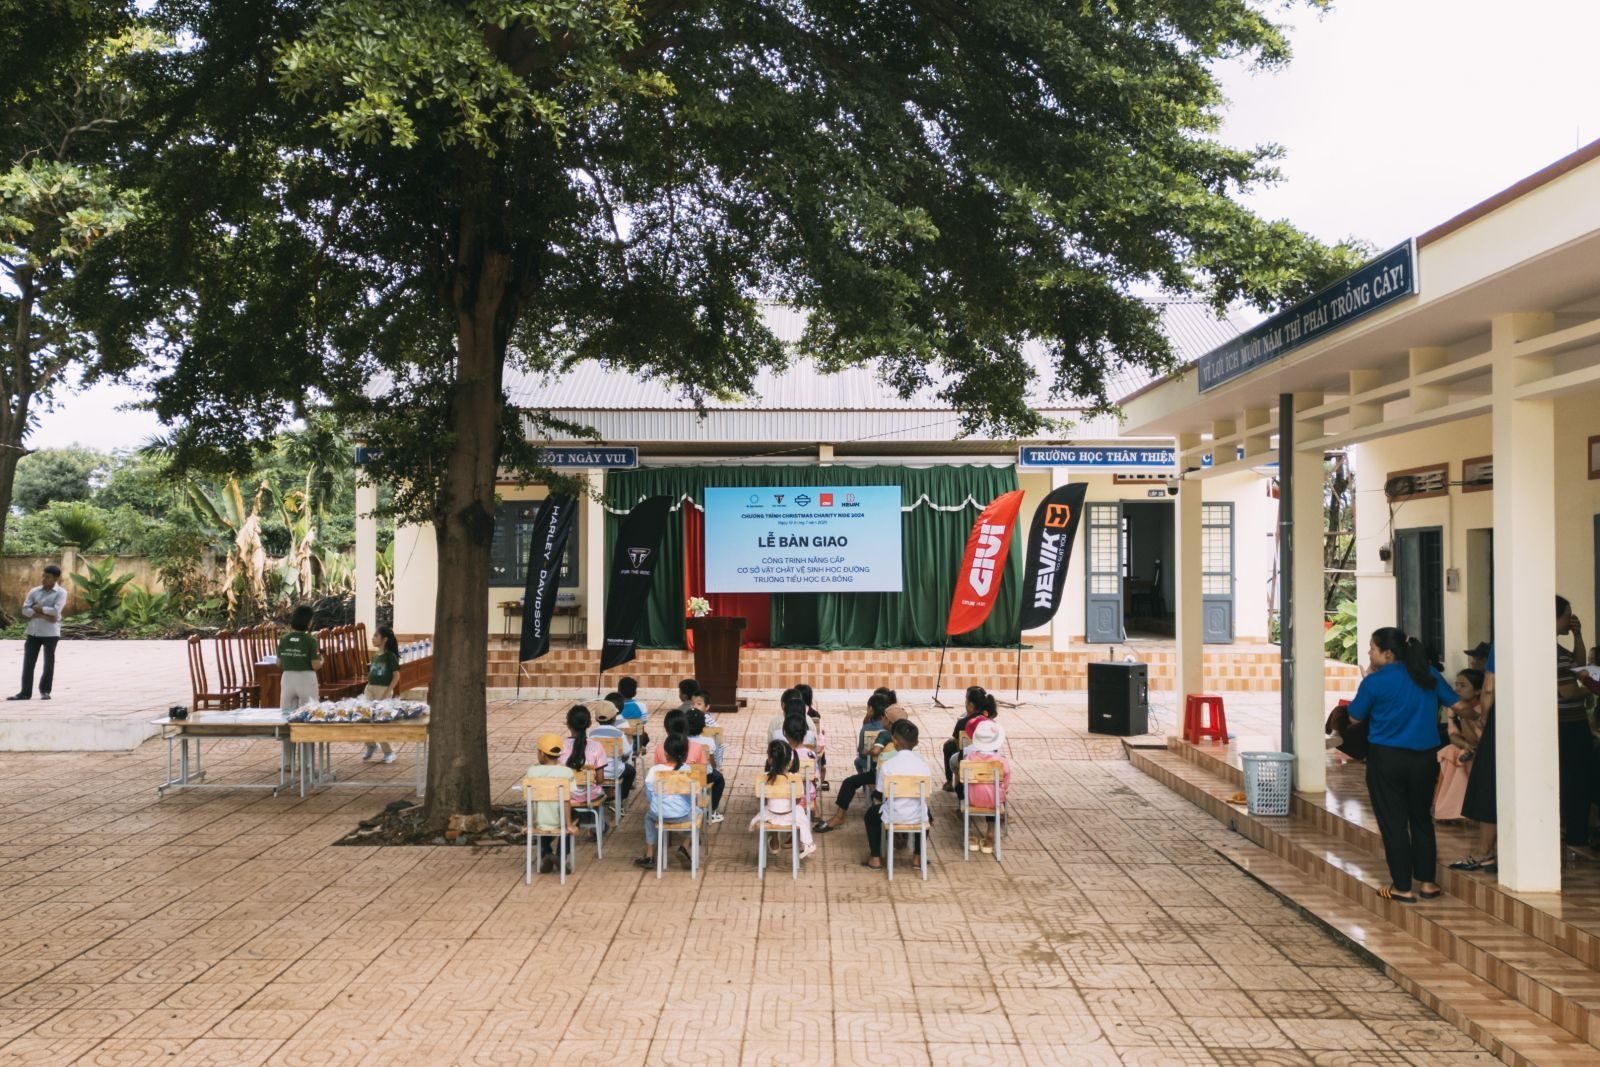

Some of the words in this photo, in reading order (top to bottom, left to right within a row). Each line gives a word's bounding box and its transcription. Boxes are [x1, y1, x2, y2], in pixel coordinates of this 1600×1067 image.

[1240, 337, 1261, 366] MƯỜI
[1262, 328, 1283, 354] NĂM
[1284, 314, 1301, 342] THÌ
[1303, 300, 1329, 335] PHẢI
[1330, 280, 1371, 320] TRỒNG
[1373, 264, 1404, 299] CÂY!
[568, 451, 601, 464] NGÀY
[605, 453, 627, 464] VUI
[1030, 450, 1075, 462] TRƯỜNG
[1079, 452, 1103, 463] HỌC
[1106, 450, 1137, 462] THÂN
[1141, 451, 1175, 464] THIỆN
[543, 505, 560, 561] HARLEY
[758, 531, 775, 547] LỄ
[779, 533, 809, 547] BÀN
[813, 536, 848, 547] GIAO
[825, 566, 842, 574] HỌC
[1034, 528, 1061, 609] HEVIK
[534, 569, 548, 638] DAVIDSON
